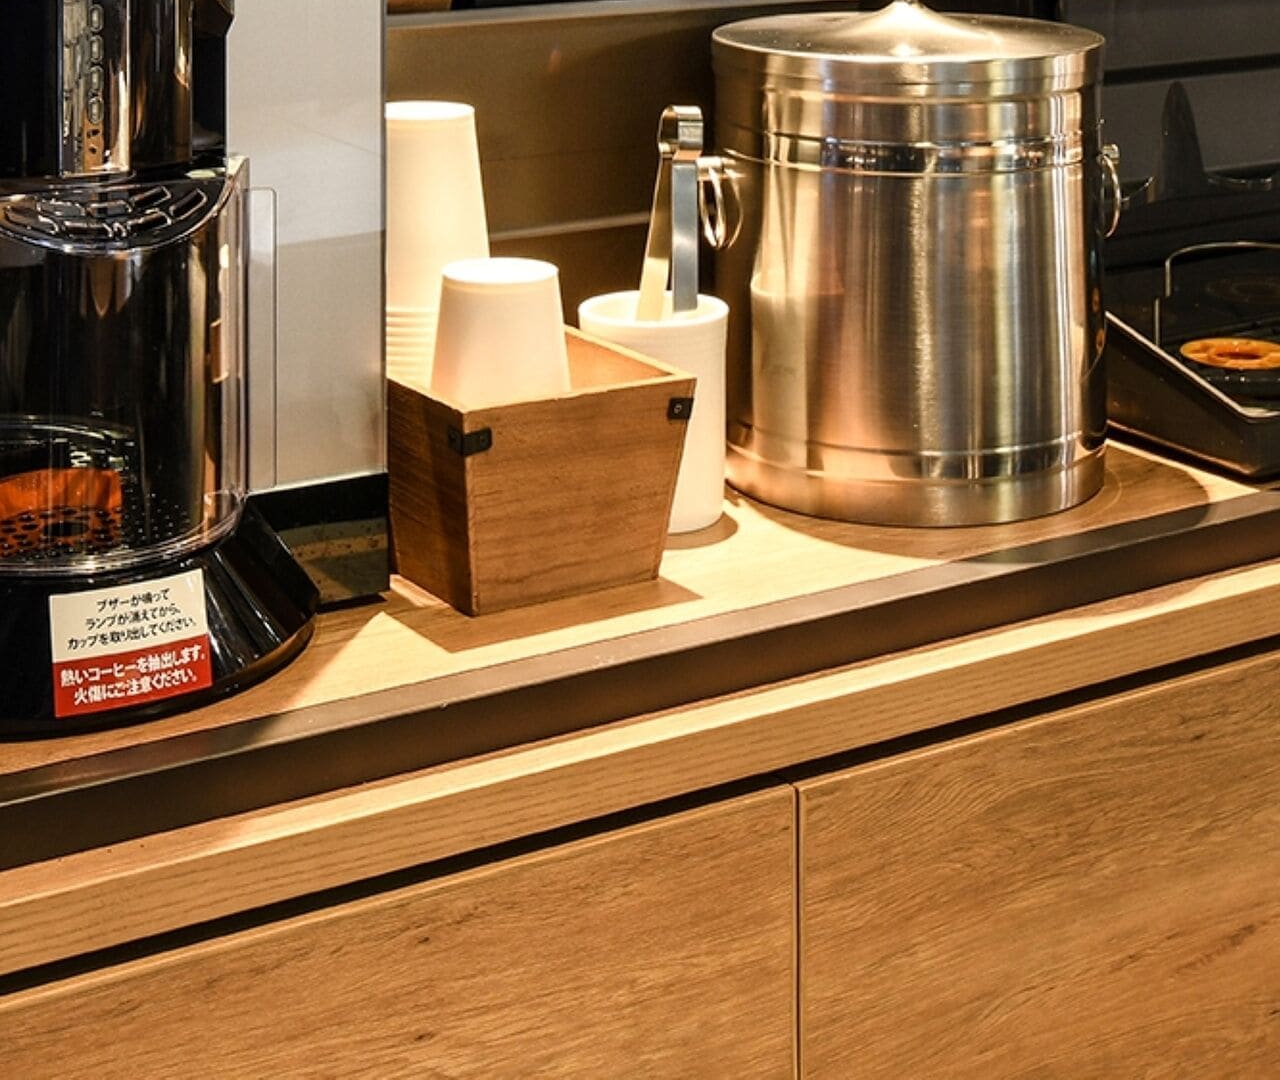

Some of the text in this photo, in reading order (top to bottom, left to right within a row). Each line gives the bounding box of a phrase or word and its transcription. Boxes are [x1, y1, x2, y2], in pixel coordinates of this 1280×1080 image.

[97, 587, 170, 612] ブザーが鳴って
[60, 644, 206, 688] 熱いコーヒーを抽出します。
[73, 668, 198, 706] 火傷にご注意ください。
